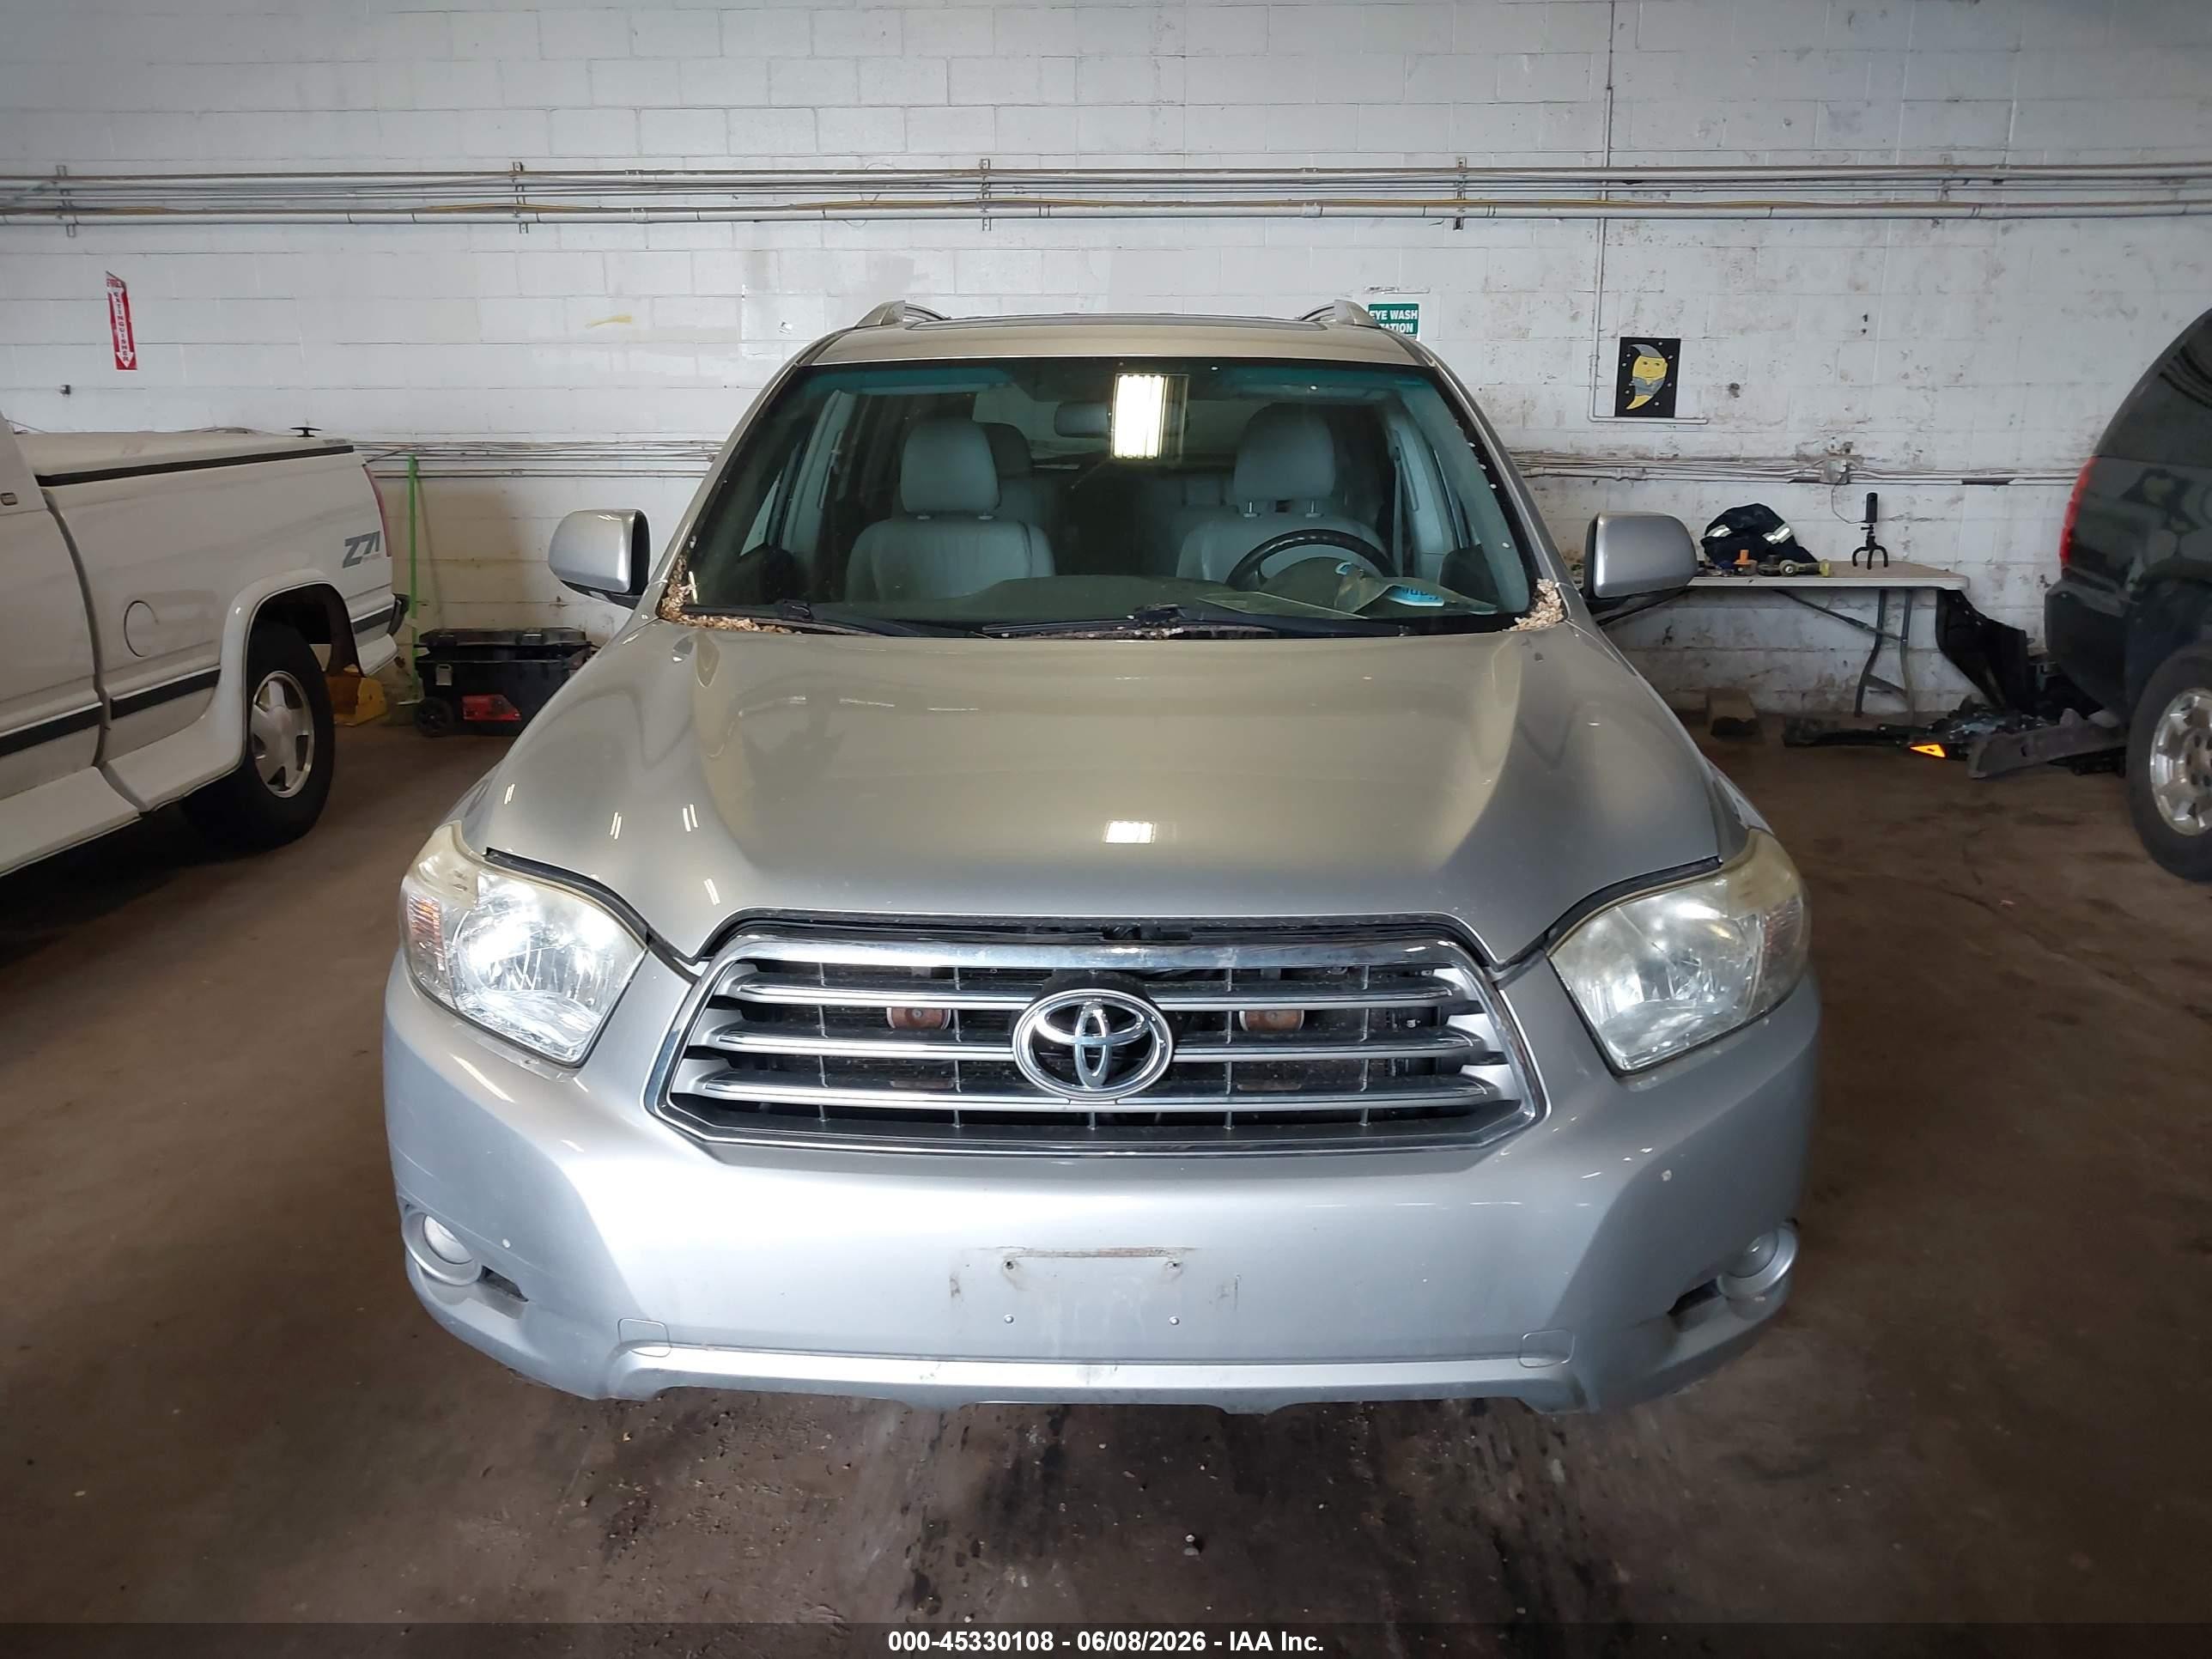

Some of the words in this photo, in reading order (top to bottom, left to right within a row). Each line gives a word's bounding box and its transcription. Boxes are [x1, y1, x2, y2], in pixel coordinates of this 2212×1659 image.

[113, 292, 129, 362] EXTINGUISHER
[1389, 310, 1418, 320] WASH
[343, 531, 380, 568] Z71
